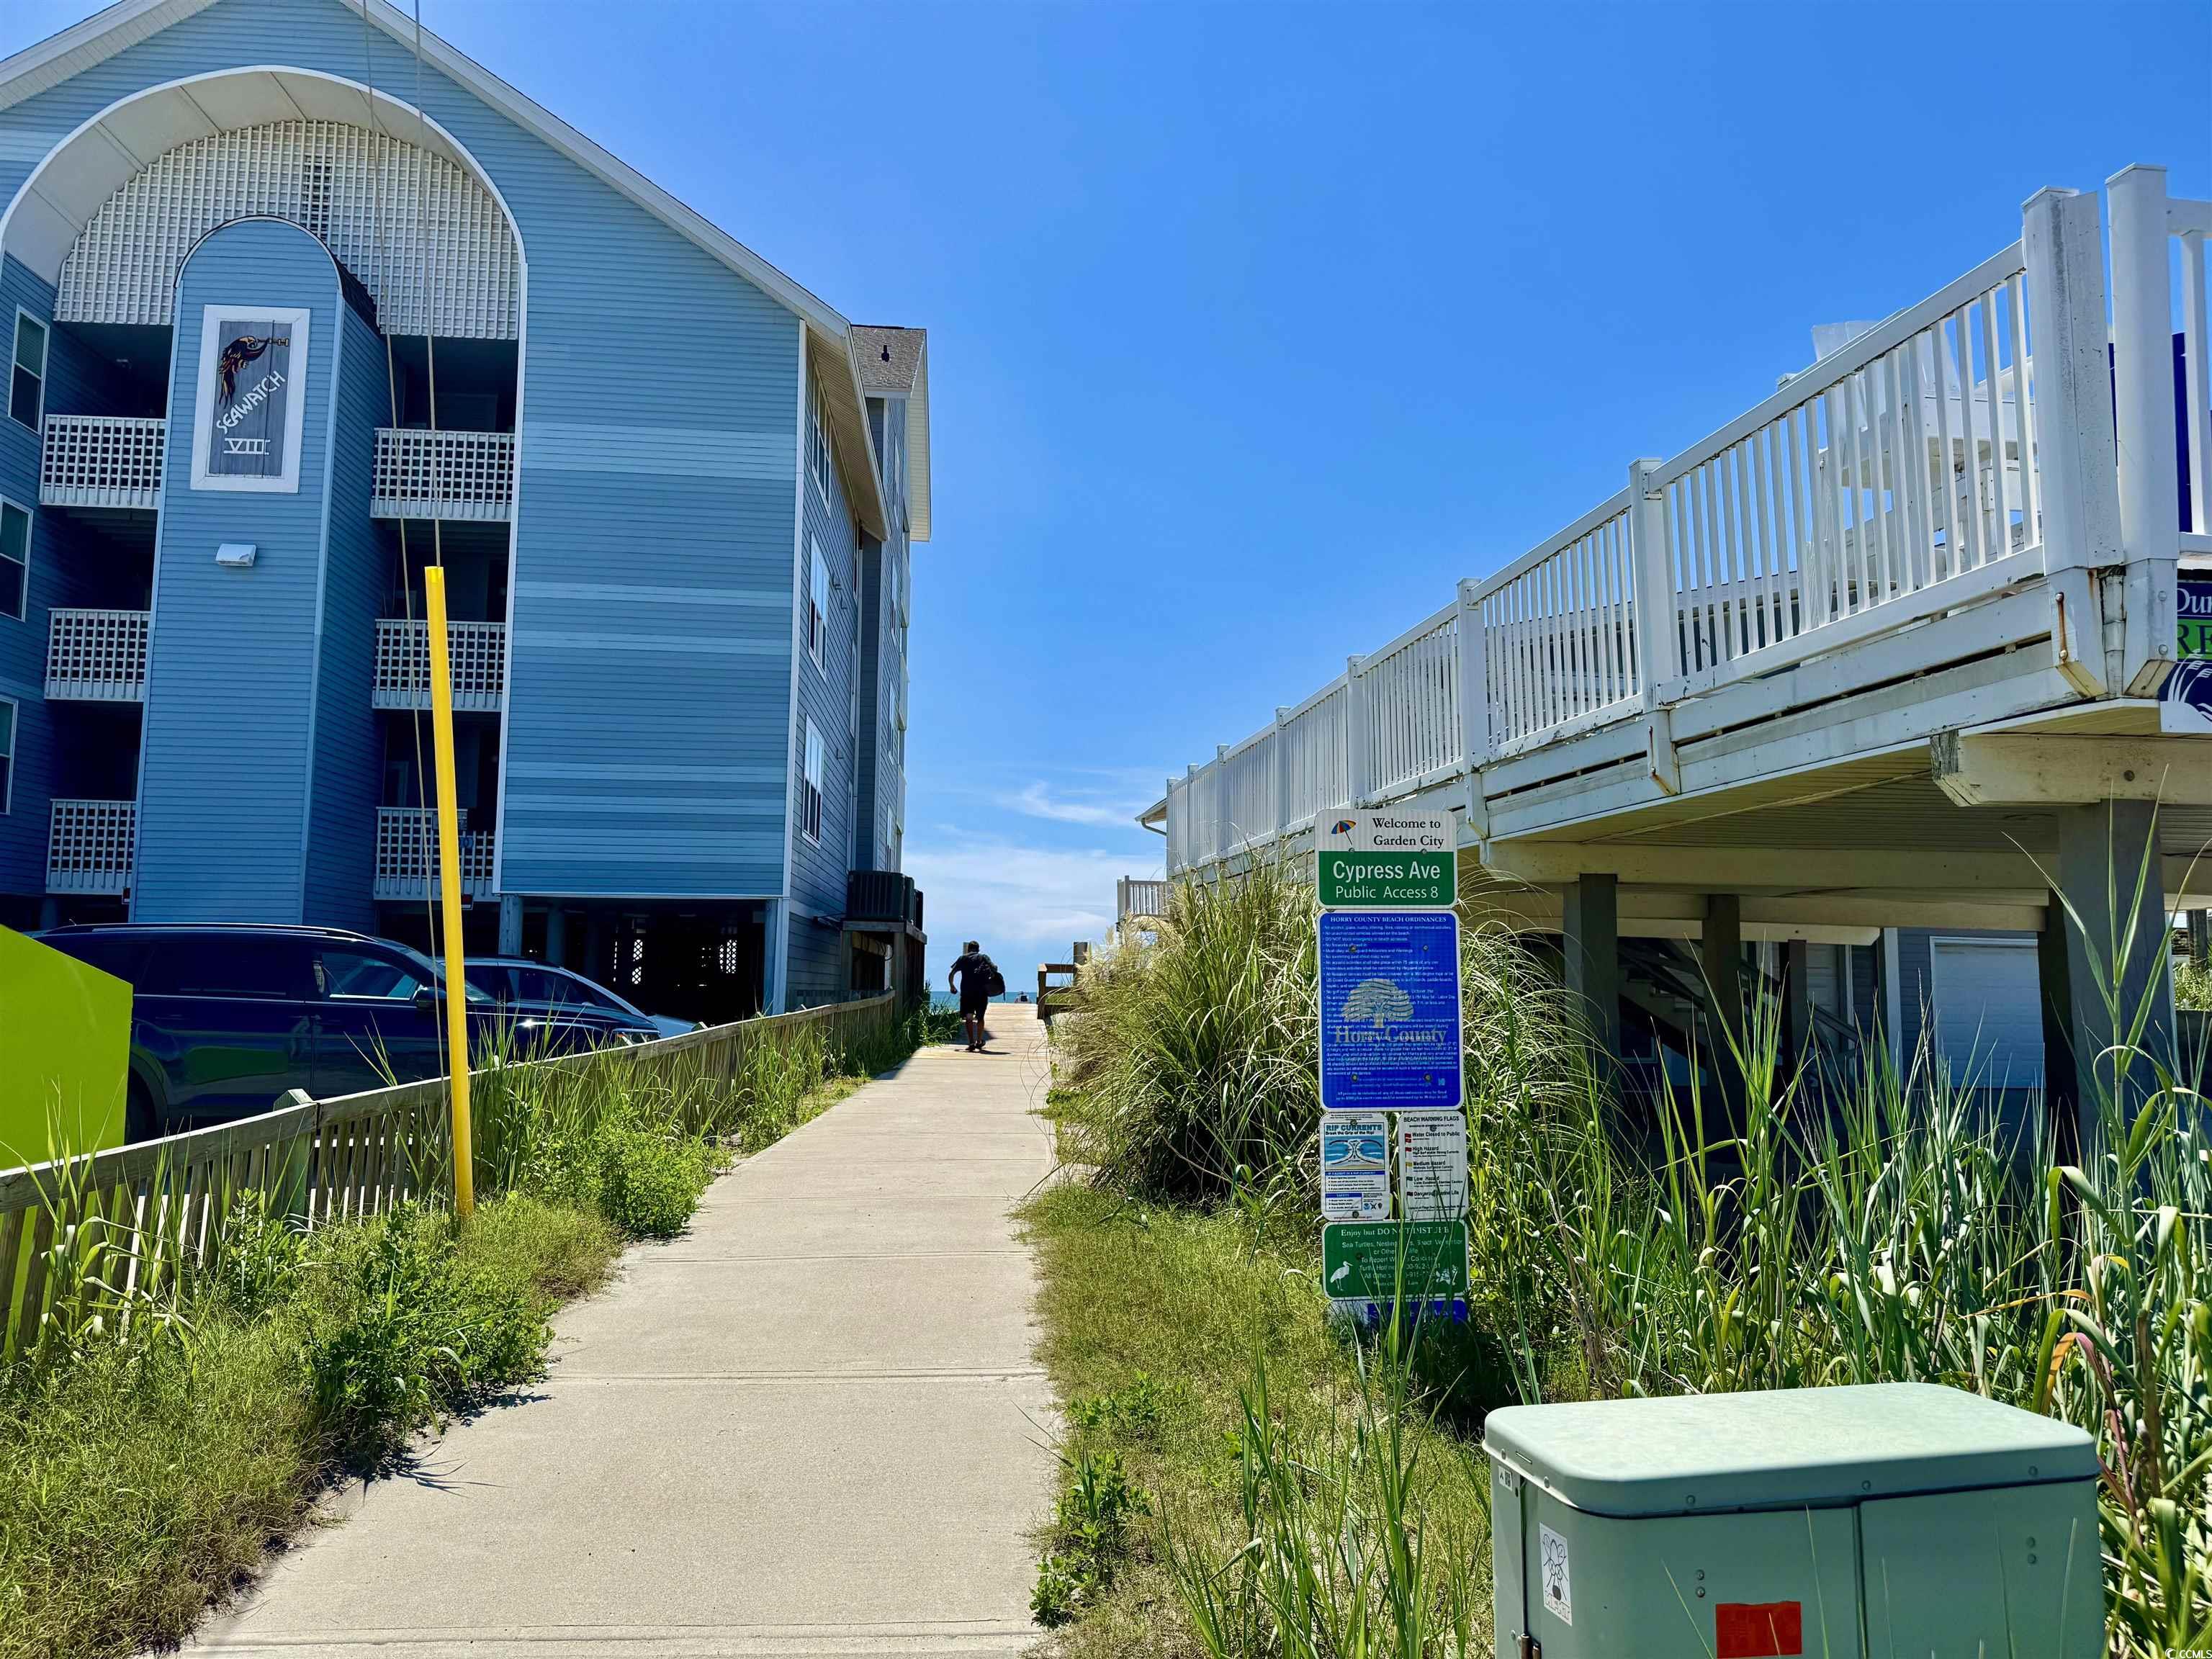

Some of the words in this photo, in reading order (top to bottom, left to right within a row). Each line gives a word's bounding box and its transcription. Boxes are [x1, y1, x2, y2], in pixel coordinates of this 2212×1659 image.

[216, 370, 286, 435] SEAWATCH
[224, 437, 271, 455] VIII
[1372, 817, 1426, 829] Welcome
[1429, 819, 1441, 829] to
[1373, 835, 1416, 846] Garden
[1420, 835, 1444, 848] City
[1333, 860, 1404, 883] Cypress
[1408, 860, 1441, 879] Ave
[1336, 886, 1377, 899] Public
[1383, 886, 1427, 899] Access
[1431, 886, 1439, 899] 8
[1335, 1025, 1385, 1046] Horry
[1385, 1025, 1447, 1046] County
